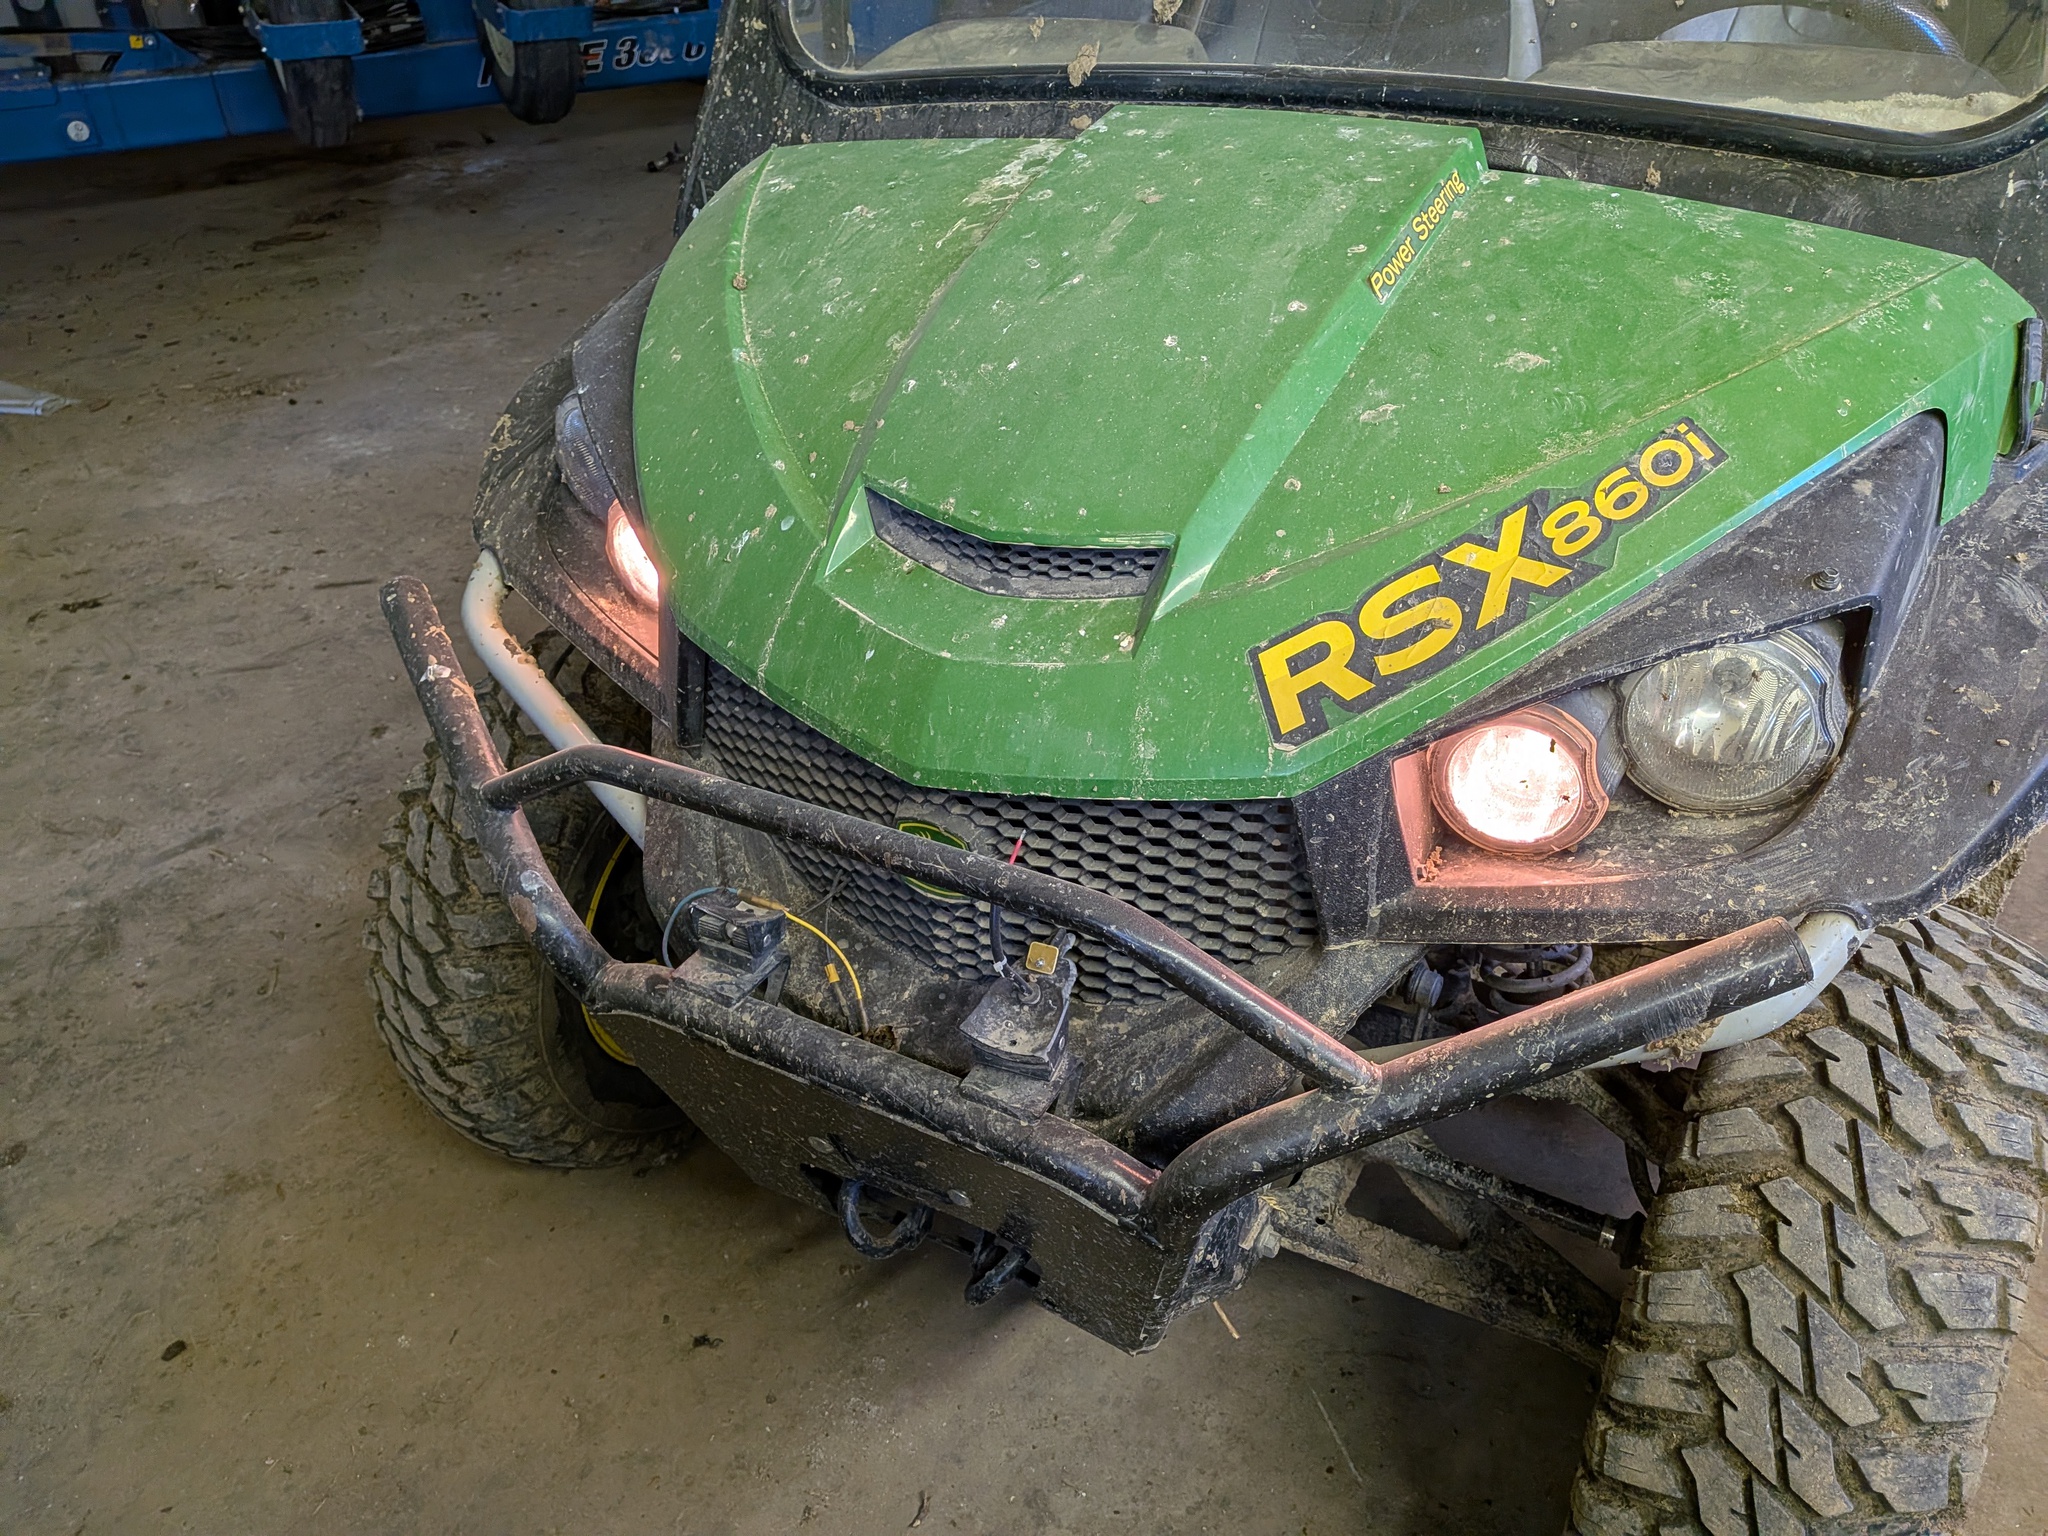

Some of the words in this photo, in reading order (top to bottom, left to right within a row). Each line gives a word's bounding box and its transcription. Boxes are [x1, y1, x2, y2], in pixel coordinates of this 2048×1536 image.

[1371, 236, 1415, 299] Power
[1412, 171, 1465, 241] Steering
[1258, 505, 1572, 735] RSX
[1542, 423, 1716, 557] 860i
